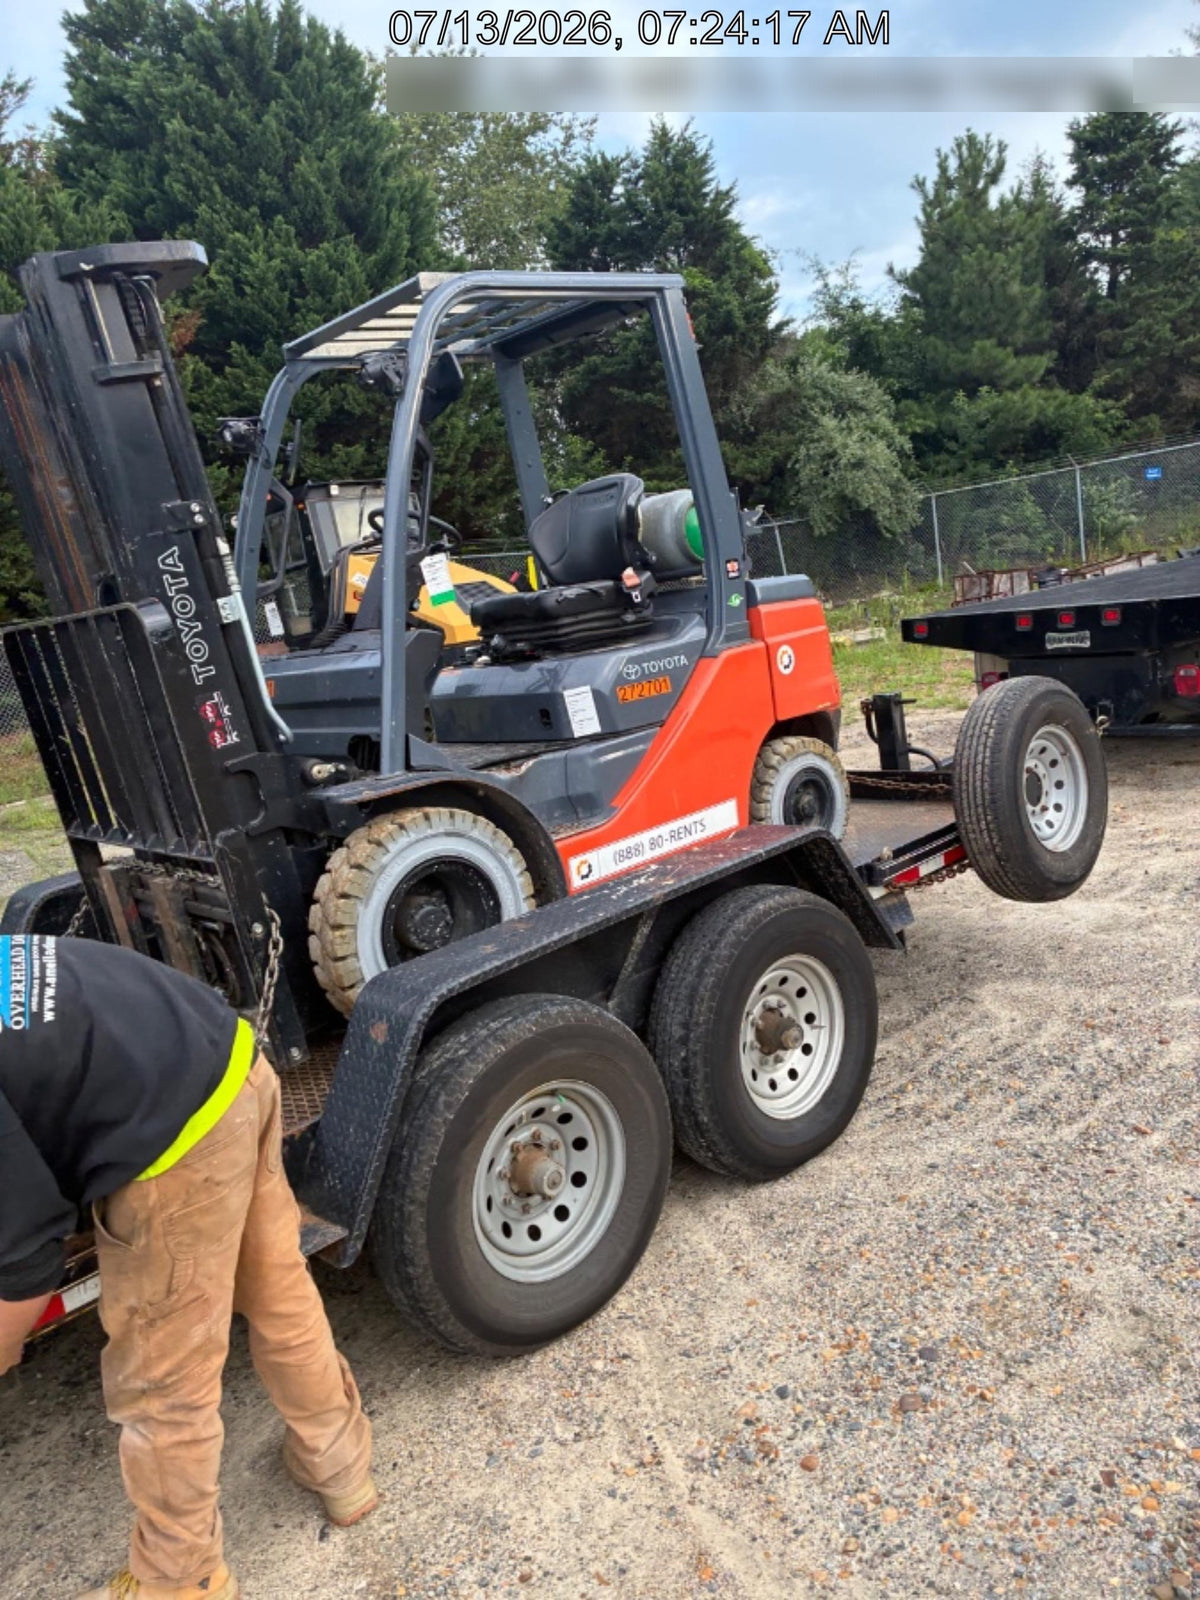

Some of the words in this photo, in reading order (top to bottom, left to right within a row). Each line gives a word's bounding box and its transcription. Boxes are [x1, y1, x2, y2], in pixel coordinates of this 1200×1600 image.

[158, 546, 216, 685] TOYOTA
[641, 654, 689, 675] TOYOTA
[618, 677, 670, 701] 272701
[613, 841, 645, 866] (888)
[648, 818, 708, 851] 80-RENTS
[10, 947, 26, 1030] OVERHEAD
